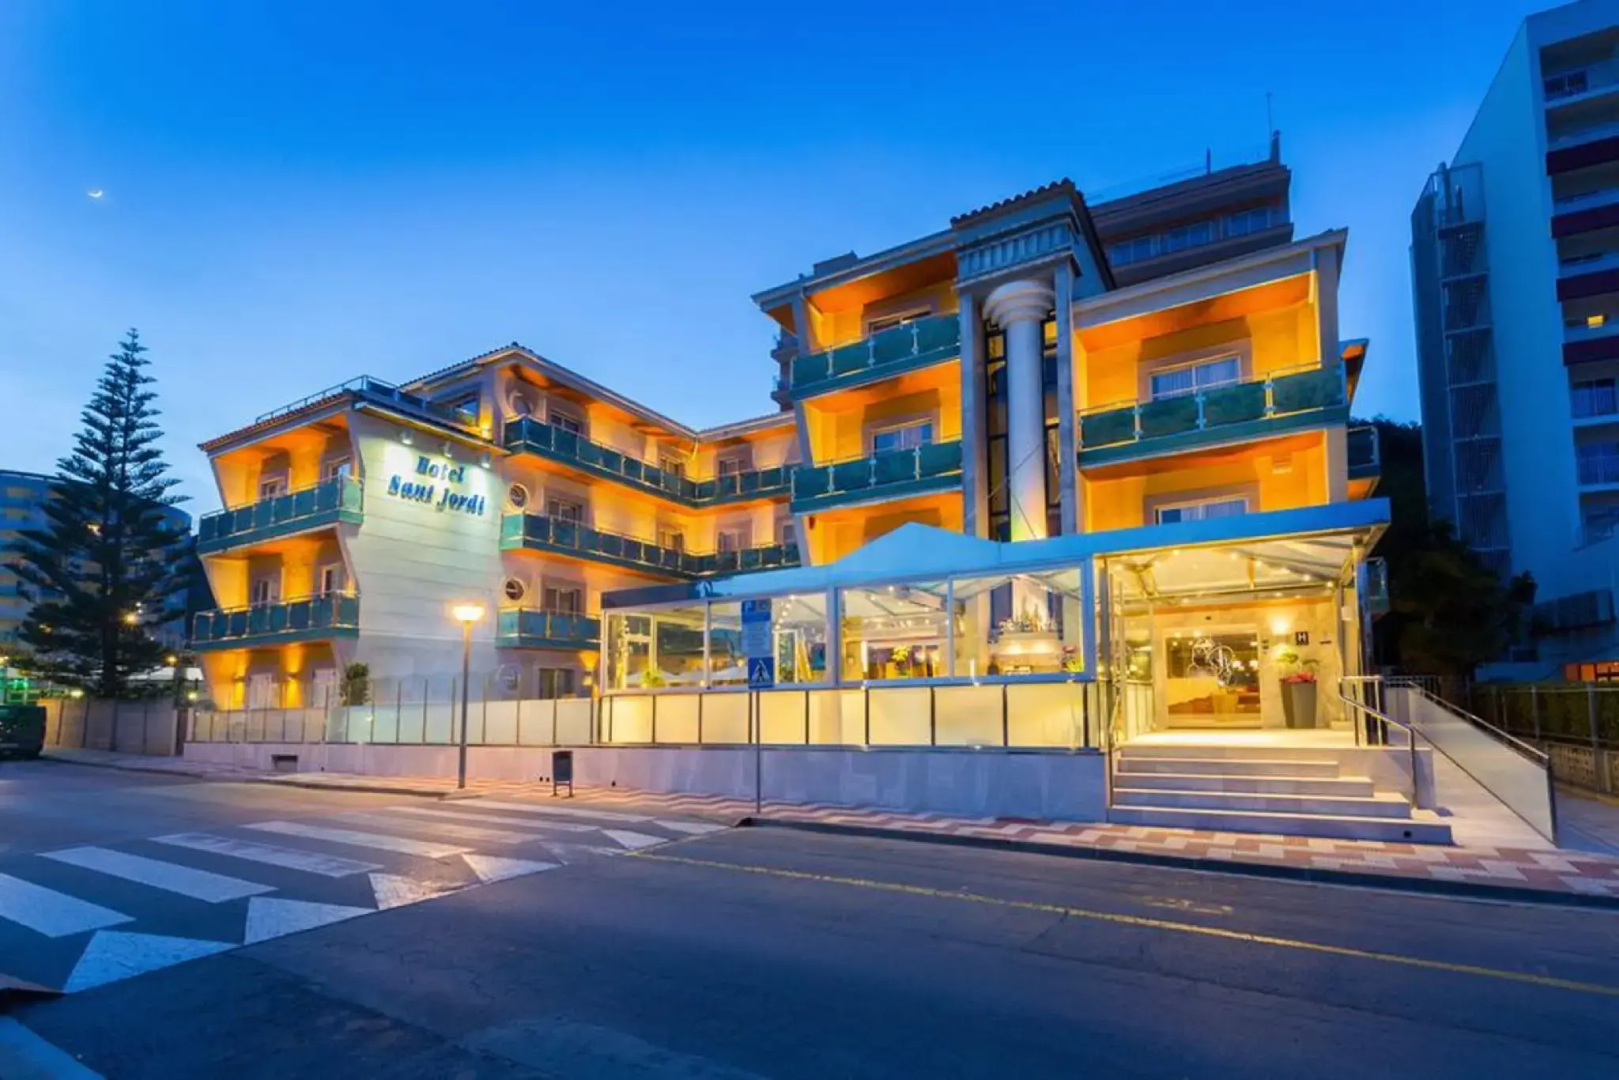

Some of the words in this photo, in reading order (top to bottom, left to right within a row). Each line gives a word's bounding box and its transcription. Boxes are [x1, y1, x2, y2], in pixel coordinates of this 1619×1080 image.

[416, 456, 464, 483] Hotel
[388, 473, 434, 503] Sant
[436, 488, 485, 516] Jordi
[1298, 632, 1306, 642] H
